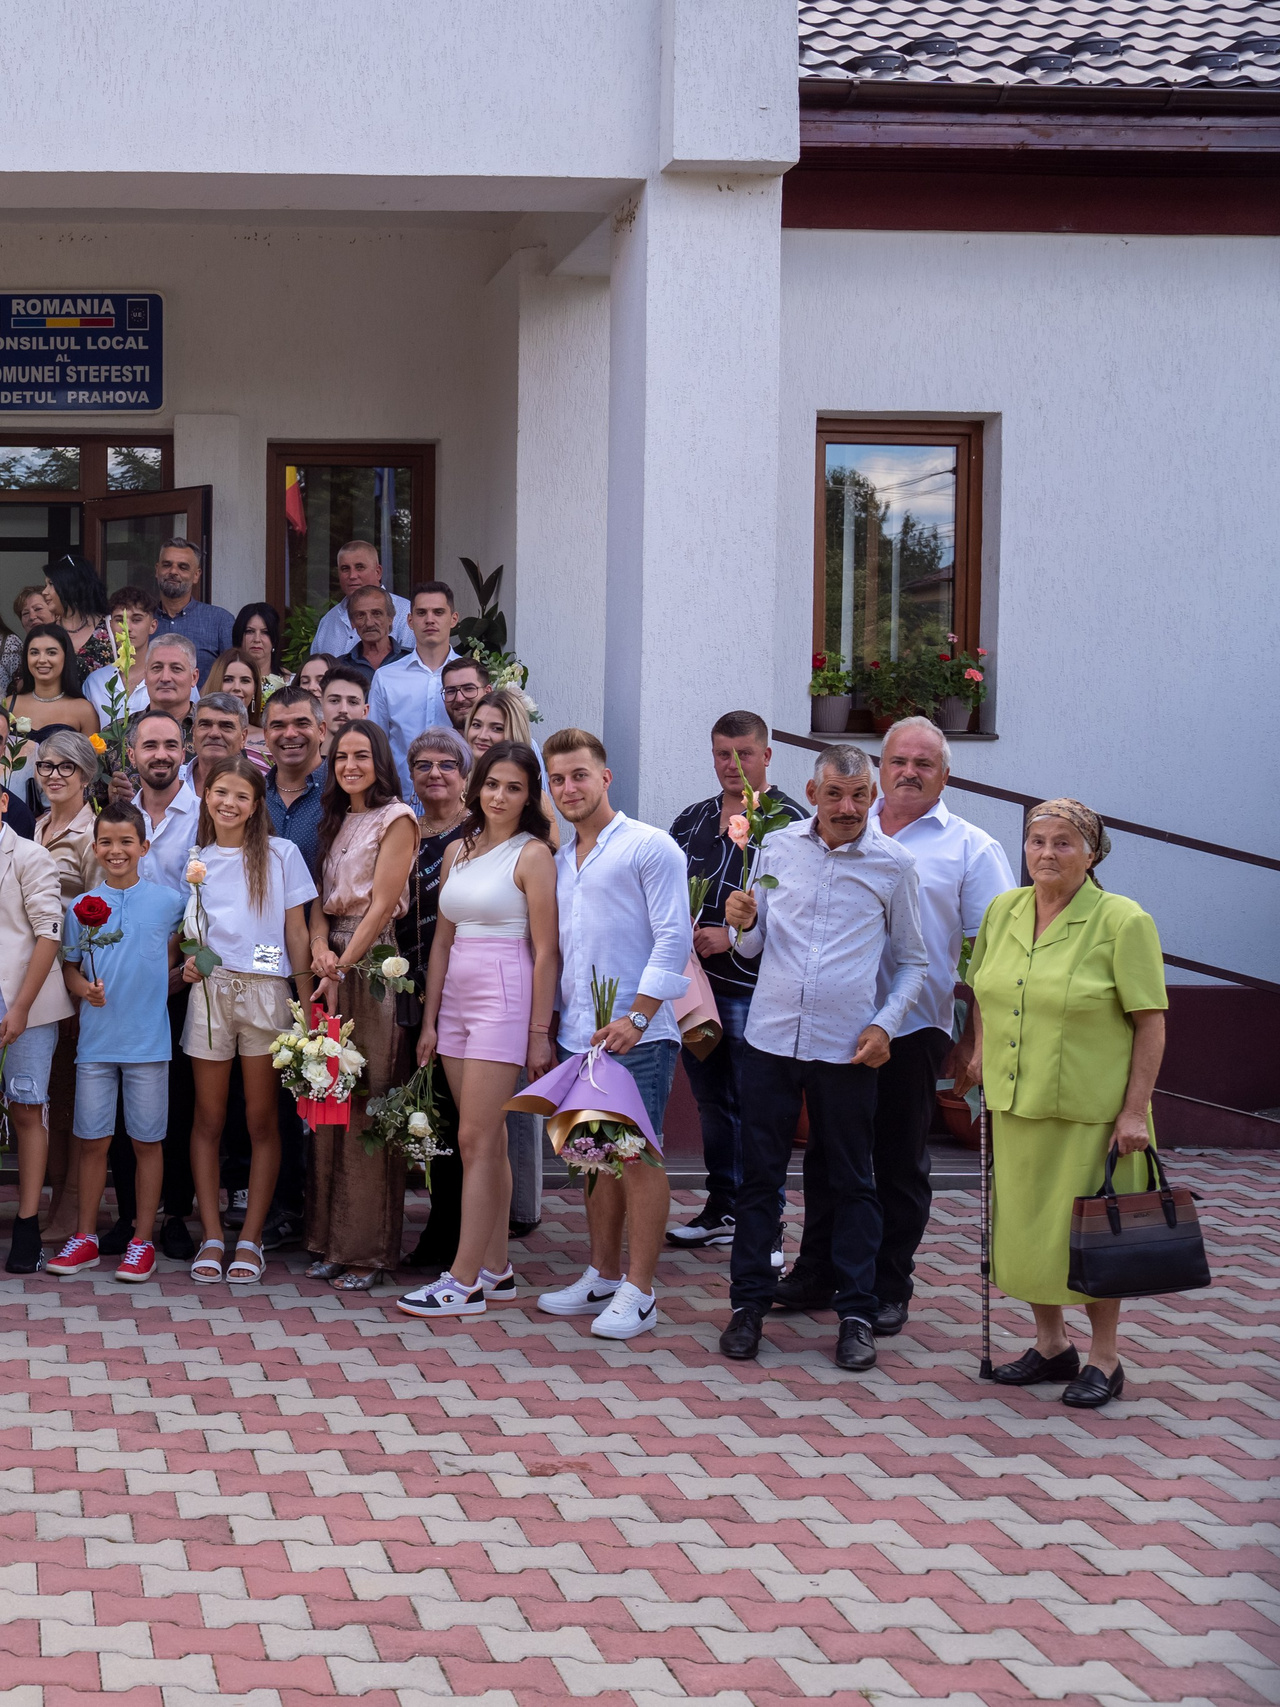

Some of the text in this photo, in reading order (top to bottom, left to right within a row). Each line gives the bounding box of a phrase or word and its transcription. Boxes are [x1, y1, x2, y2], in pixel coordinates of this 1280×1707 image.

[11, 298, 116, 315] ROMANIA
[86, 336, 149, 351] LOCAL
[55, 353, 71, 363] AL
[66, 365, 150, 383] STEFESTI
[67, 390, 150, 404] PRAHOVA
